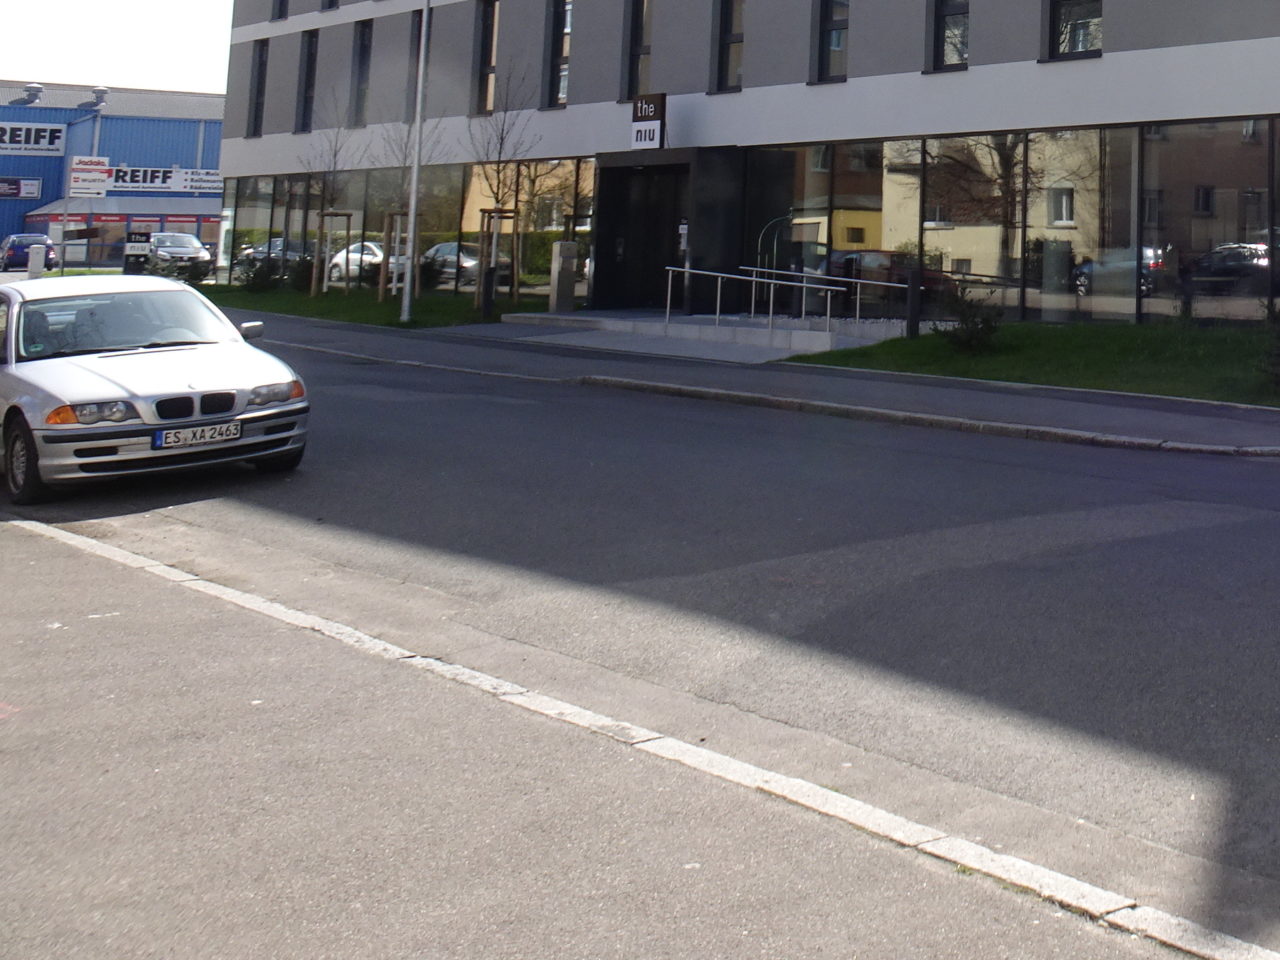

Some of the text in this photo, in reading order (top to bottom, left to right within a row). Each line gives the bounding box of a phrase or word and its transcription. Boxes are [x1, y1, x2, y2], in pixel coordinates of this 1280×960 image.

[637, 99, 655, 117] the
[635, 128, 655, 142] niu
[114, 168, 173, 184] REIFF
[131, 234, 147, 242] the
[164, 431, 182, 445] ES
[191, 429, 206, 441] XA
[209, 423, 240, 439] 2463
